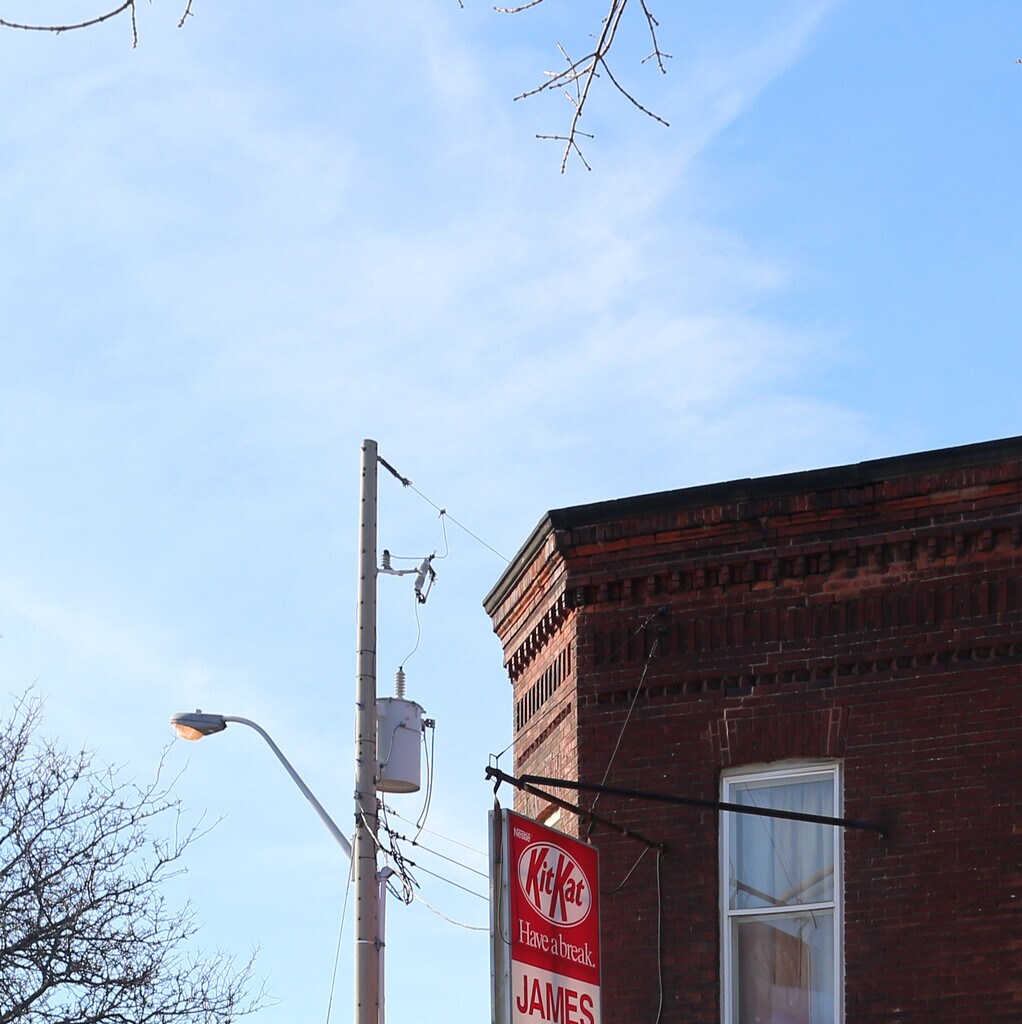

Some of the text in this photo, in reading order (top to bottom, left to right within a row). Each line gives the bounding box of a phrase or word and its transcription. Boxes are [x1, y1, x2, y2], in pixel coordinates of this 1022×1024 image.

[526, 847, 585, 922] KitKat
[519, 918, 596, 968] Have a break.
